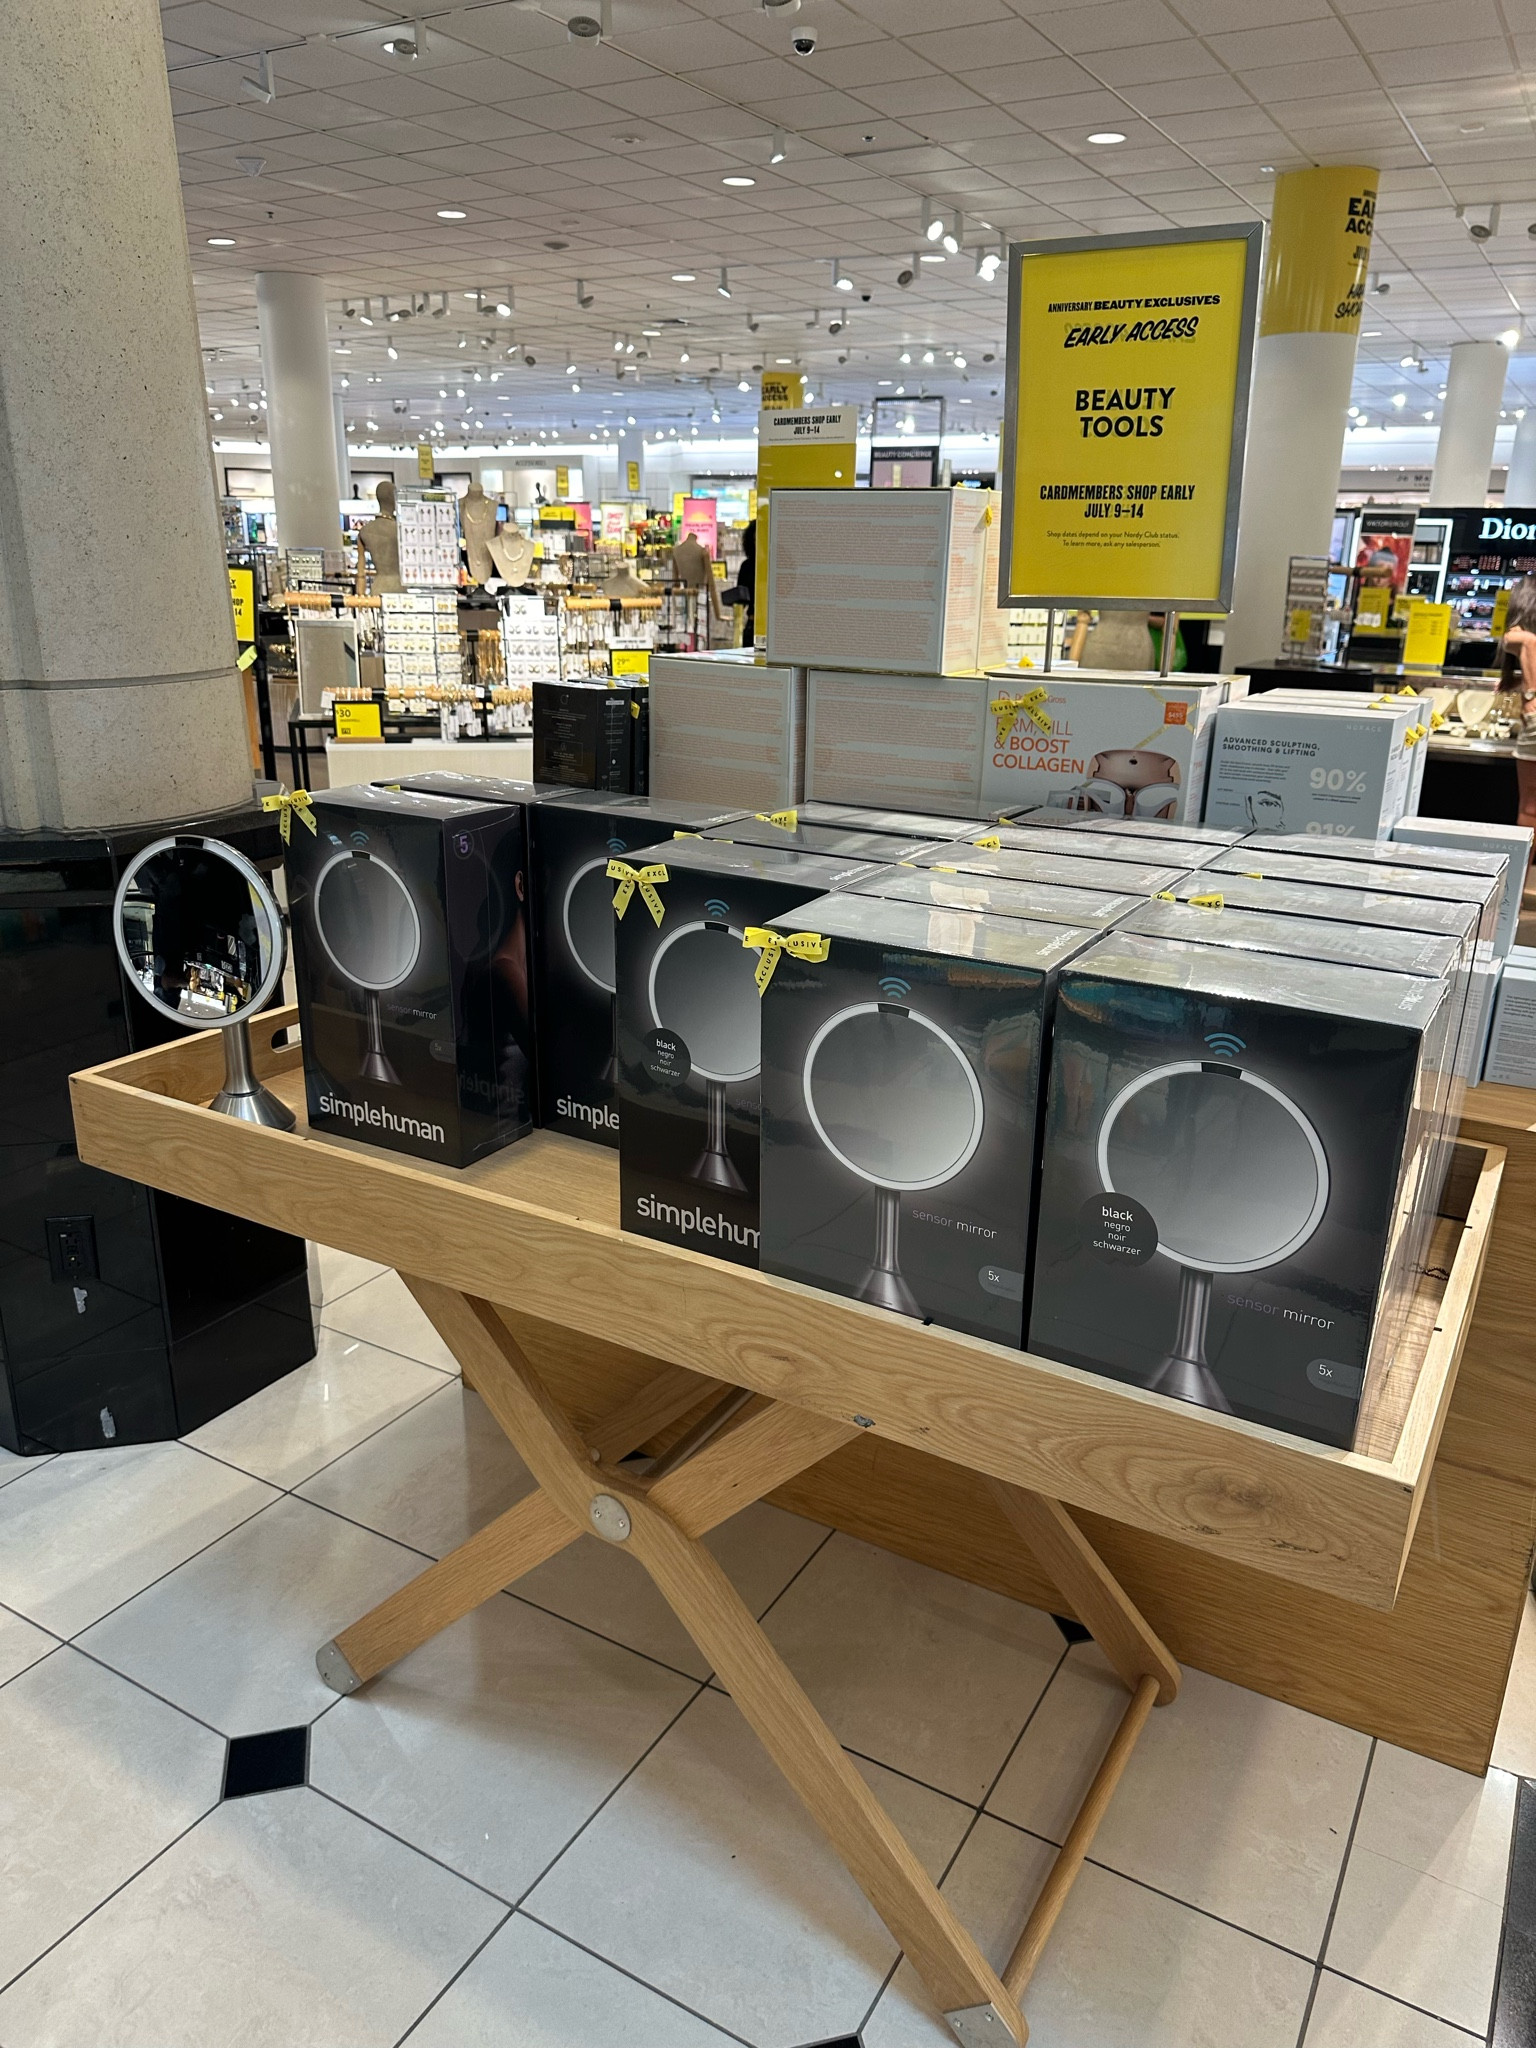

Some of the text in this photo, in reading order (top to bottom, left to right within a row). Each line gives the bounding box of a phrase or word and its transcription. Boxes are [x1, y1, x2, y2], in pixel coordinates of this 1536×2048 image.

[1048, 295, 1220, 312] ANNIVERSARY BEAUTY EXCLUSIVES
[1064, 316, 1199, 348] EARLY ACCESS
[1076, 387, 1176, 411] BEAUTY
[774, 415, 842, 426] CARDMEMBERS SHOP EARLY
[1080, 415, 1164, 438] TOOLS
[794, 427, 806, 435] JULY
[1040, 485, 1195, 500] CARDMEMBERS SHOP EARLY
[1084, 504, 1110, 518] JULY
[1478, 518, 1536, 540] Dior
[996, 717, 1036, 736] FRM,
[1010, 736, 1070, 754] BOOST
[1222, 744, 1272, 754] SMOOTHING
[1283, 749, 1316, 757] LIFTING
[1224, 736, 1320, 750] ADVANCED SCULPTING,
[993, 753, 1084, 774] COLLAGEN
[1310, 767, 1367, 793] 90%
[458, 835, 468, 854] 5
[412, 1008, 437, 1020] mirror
[656, 1039, 676, 1051] black
[658, 1050, 674, 1059] negro
[650, 1064, 680, 1077] schwarzer
[319, 1092, 445, 1144] simplehuman
[556, 1095, 620, 1131] simple
[1102, 1206, 1133, 1222] black
[912, 1210, 997, 1238] sensor mirror
[1104, 1222, 1130, 1232] negro
[1108, 1232, 1126, 1242] noir
[1093, 1240, 1141, 1256] schwarzer
[988, 1270, 1000, 1282] 5x
[1228, 1294, 1335, 1330] sensor mirror
[1318, 1364, 1333, 1378] 5x
